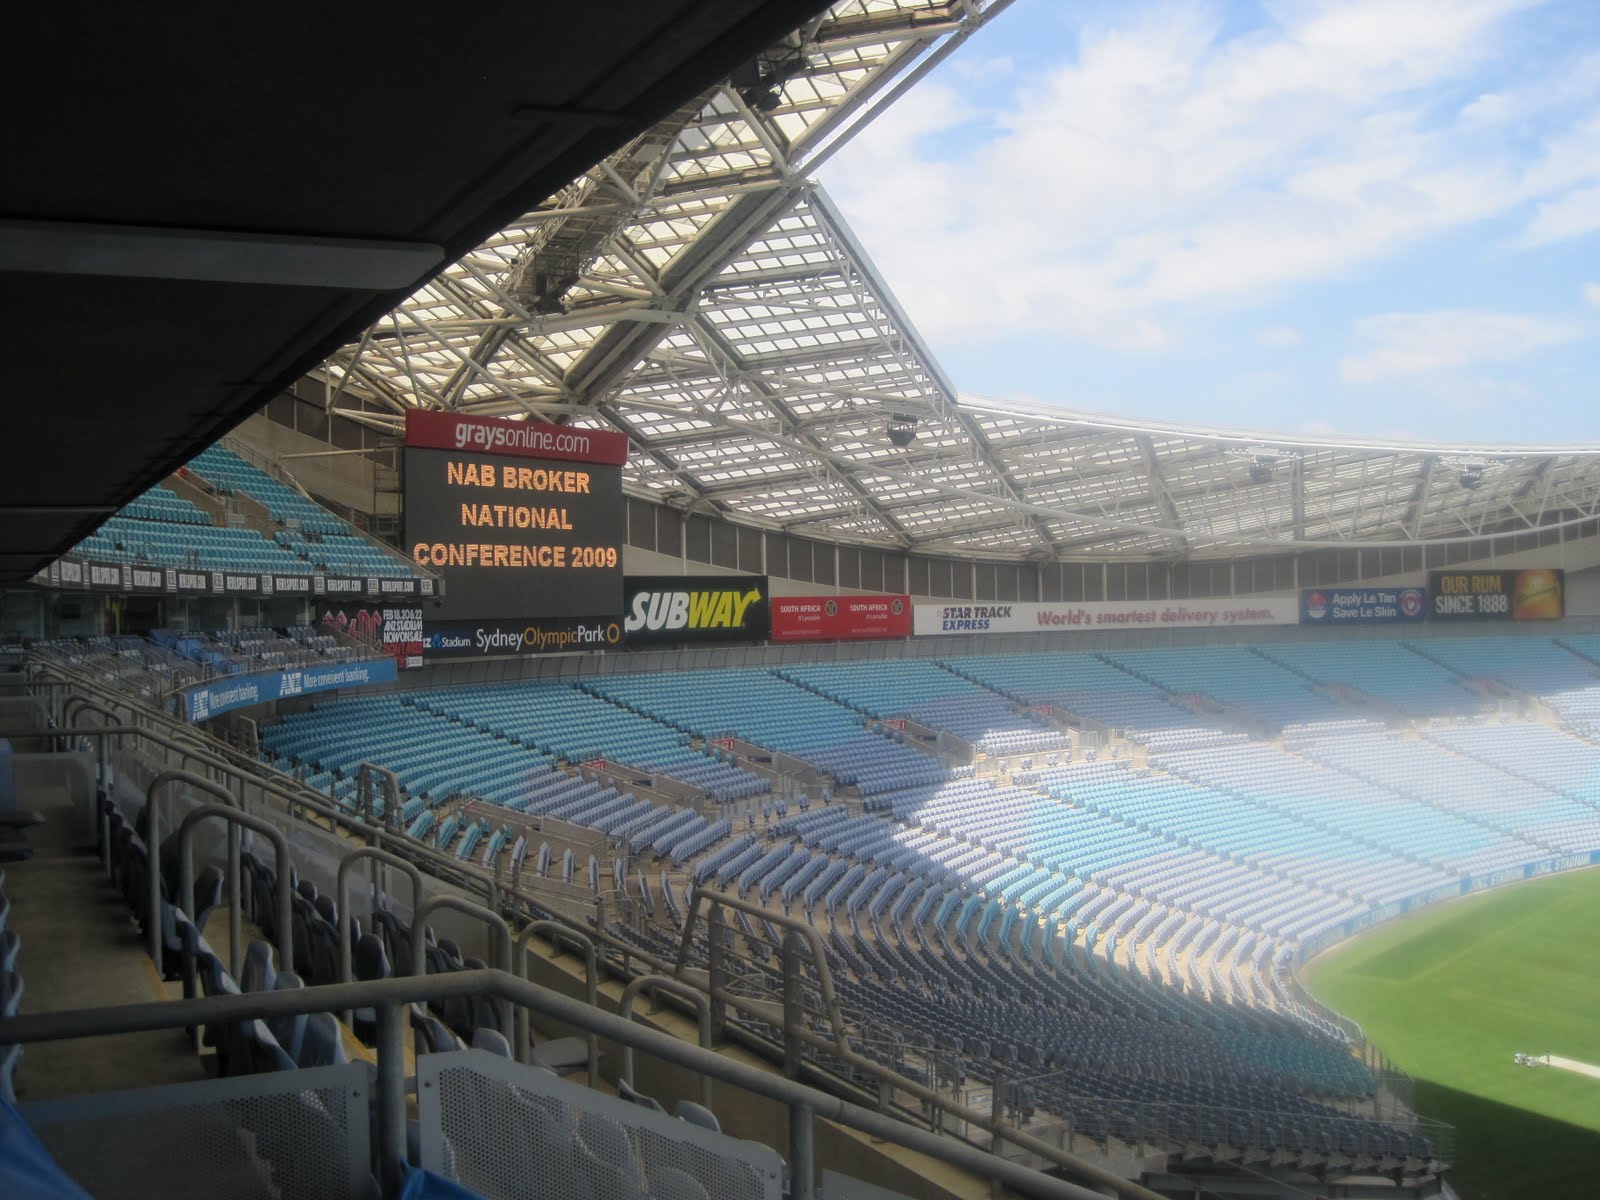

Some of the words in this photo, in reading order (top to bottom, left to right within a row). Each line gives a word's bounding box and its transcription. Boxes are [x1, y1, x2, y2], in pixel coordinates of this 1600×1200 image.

[455, 422, 590, 454] graysonline.com
[447, 461, 496, 487] NAB
[503, 466, 591, 494] BROKER
[461, 503, 573, 530] NATIONAL
[413, 543, 566, 568] CONFERENCE
[571, 546, 618, 568] 2009
[1441, 575, 1468, 593] OUR
[1472, 575, 1502, 593] RUM
[868, 603, 888, 611] AFRICA
[1332, 593, 1361, 607] Apply
[1363, 592, 1376, 604] Le
[1377, 592, 1396, 604] Tan
[1436, 595, 1474, 613] SINCE
[1477, 595, 1508, 613] 1888
[383, 609, 394, 620] FEB
[624, 585, 761, 633] SUBWAY
[780, 605, 799, 613] SOUTH
[800, 604, 820, 613] AFRICA
[942, 607, 972, 620] STAR
[974, 606, 1012, 618] TRACK
[1333, 607, 1358, 618] Save
[1360, 607, 1372, 617] Le
[1374, 606, 1397, 617] Skin
[1037, 609, 1092, 626] World's
[1096, 609, 1156, 625] smartest
[1223, 608, 1275, 624] system.
[384, 620, 397, 632] ANZ
[396, 620, 422, 632] STADIUM
[942, 619, 990, 631] EXPRESS
[383, 631, 400, 643] NOW
[409, 631, 423, 642] SALE
[442, 636, 471, 648] Stadium
[279, 672, 302, 696] ANZ
